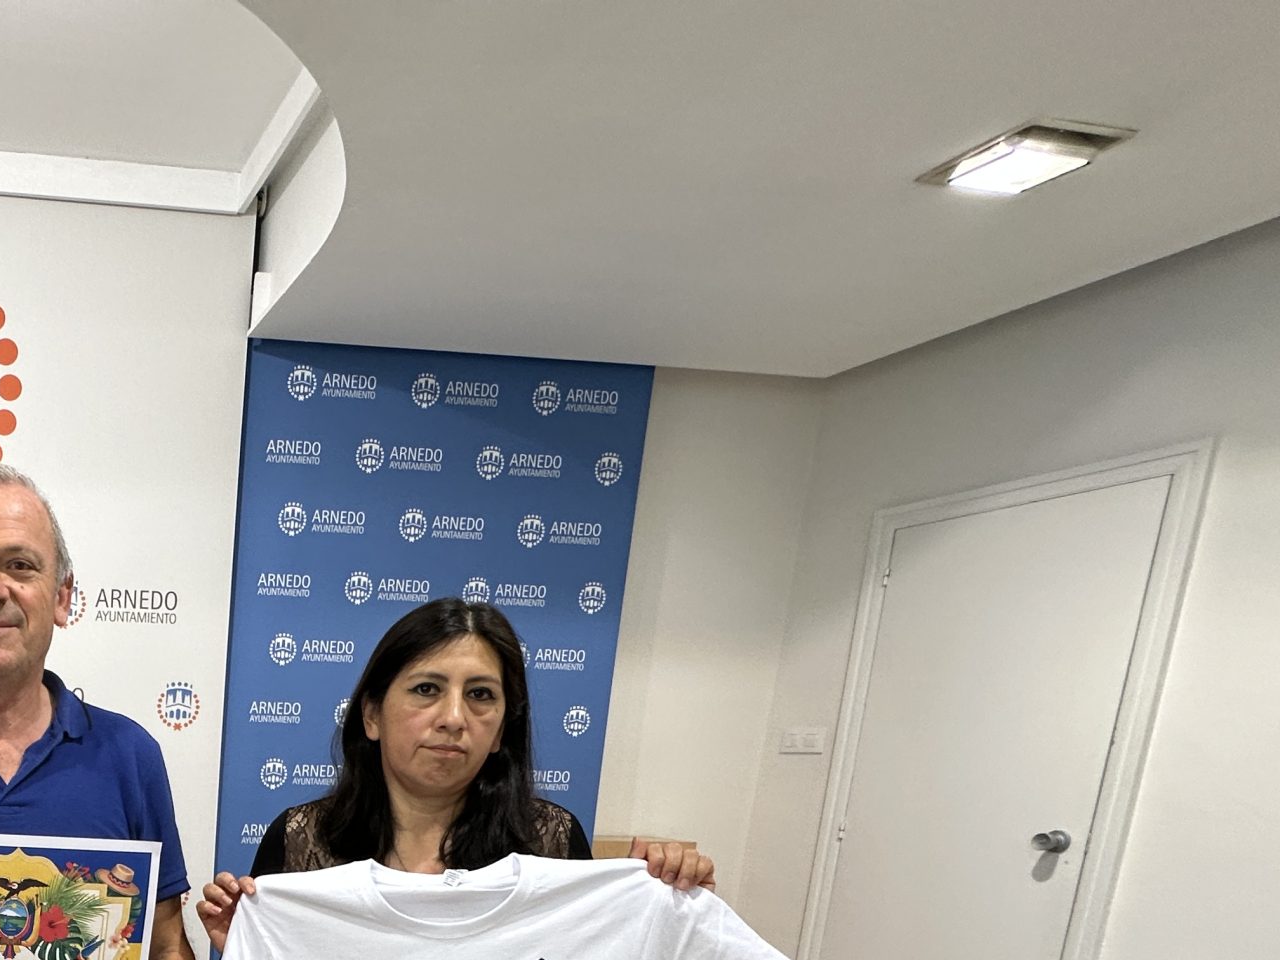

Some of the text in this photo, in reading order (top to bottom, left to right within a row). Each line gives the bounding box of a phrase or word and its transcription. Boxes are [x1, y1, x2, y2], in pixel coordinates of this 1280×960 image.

[322, 374, 377, 390] ARNEDO
[321, 387, 376, 400] AYUNTAMIENTO
[446, 382, 499, 399] ARNEDO
[444, 396, 498, 407] AYUNTAMIENTO
[566, 389, 619, 405] ARNEDO
[565, 403, 617, 414] AYUNTAMIENTO
[266, 440, 321, 456] ARNEDO
[266, 454, 320, 465] AYUNTAMIENTO
[389, 447, 443, 464] ARNEDO
[389, 461, 442, 472] AYUNTAMIENTO
[510, 454, 562, 470] ARNEDO
[508, 467, 561, 478] AYUNTAMIENTO
[312, 510, 365, 526] ARNEDO
[311, 523, 365, 534] AYUNTAMIENTO
[432, 517, 484, 532] ARNEDO
[550, 522, 602, 537] ARNEDO
[431, 530, 484, 541] AYUNTAMIENTO
[549, 535, 601, 546] AYUNTAMIENTO
[258, 574, 311, 589] ARNEDO
[378, 579, 430, 594] ARNEDO
[257, 587, 310, 598] AYUNTAMIENTO
[377, 592, 429, 602] AYUNTAMIENTO
[495, 584, 547, 599] ARNEDO
[95, 589, 178, 611] ARNEDO
[494, 596, 546, 607] AYUNTAMIENTO
[95, 609, 177, 624] AYUNTAMIENTO
[302, 641, 354, 655] ARNEDO
[301, 653, 354, 663] AYUNTAMIENTO
[535, 649, 586, 664] ARNEDO
[534, 661, 584, 671] AYUNTAMIENTO
[250, 702, 301, 716] ARNEDO
[249, 714, 301, 724] AYUNTAMIENTO
[293, 765, 334, 776] ARNED
[292, 778, 334, 786] AYUNTAMIEN
[531, 771, 570, 783] RNEDO
[241, 824, 266, 836] ARN
